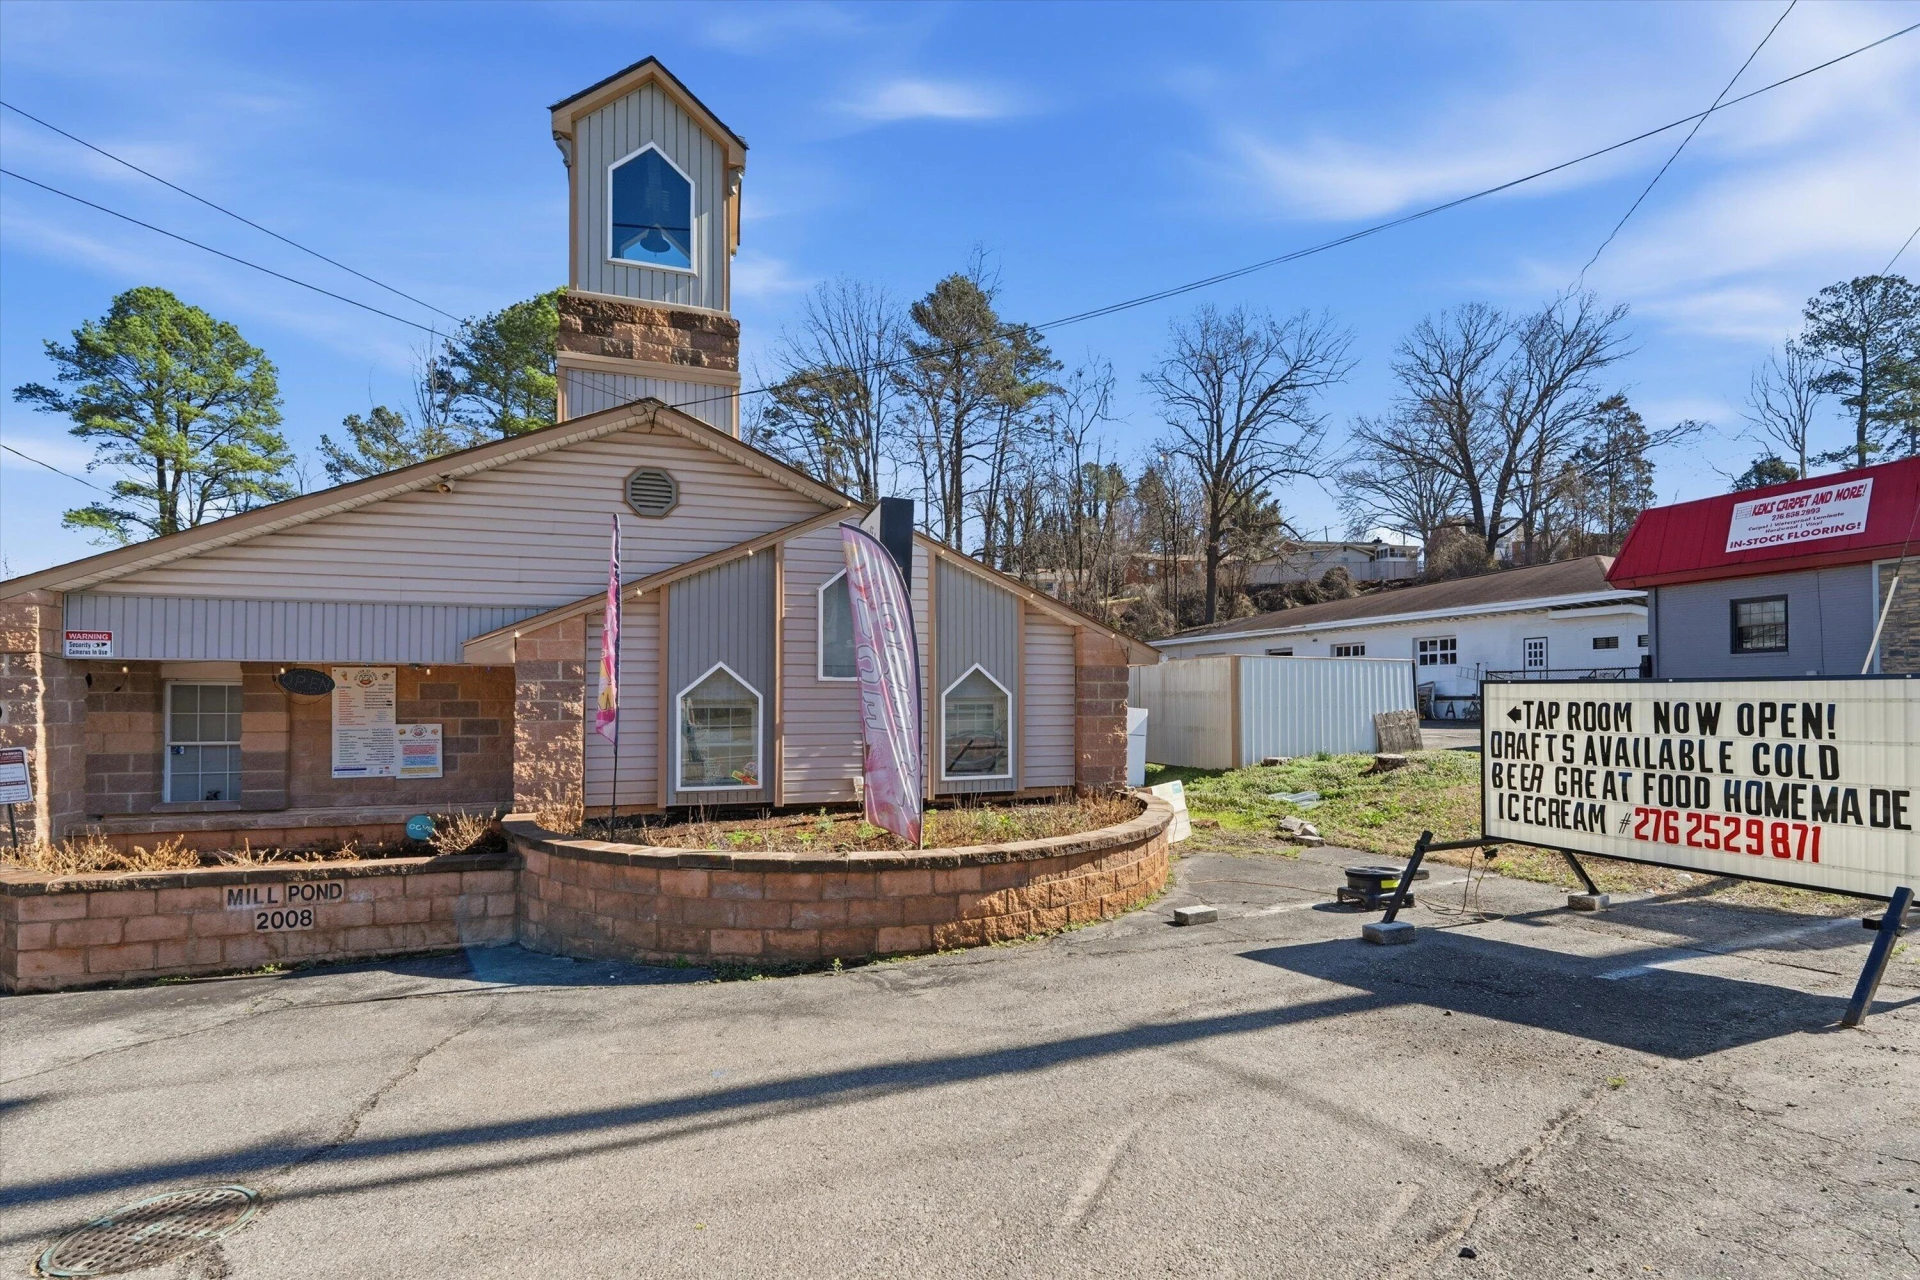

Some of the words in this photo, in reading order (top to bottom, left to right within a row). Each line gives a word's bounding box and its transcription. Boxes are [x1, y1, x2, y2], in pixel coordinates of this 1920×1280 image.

[1776, 495, 1811, 512] CARPET
[1811, 491, 1833, 505] AND
[1834, 484, 1867, 502] MORE!
[1730, 533, 1784, 548] IN-STOCK
[1787, 522, 1861, 540] FLOORING!
[1748, 523, 1769, 531] Carpet
[1765, 525, 1798, 534] Hardwood
[1805, 520, 1823, 528] Vinyl
[68, 632, 108, 640] WARNING
[69, 641, 91, 649] Security
[1523, 701, 1560, 730] TAP
[1567, 701, 1632, 732] ROOM
[1654, 701, 1721, 736] NOW
[1737, 702, 1836, 739] OPEN!
[1491, 731, 1575, 764] DRAFTS
[1584, 735, 1733, 774] AVAILABLE
[1752, 743, 1839, 780] COLD
[1492, 762, 1544, 793] BEER
[1555, 766, 1632, 802] GREAT
[1643, 773, 1710, 809] FOOD
[1724, 779, 1911, 830] HOMEMADE
[228, 887, 278, 906] MILL
[288, 883, 342, 902] POND
[257, 909, 312, 930] 2008
